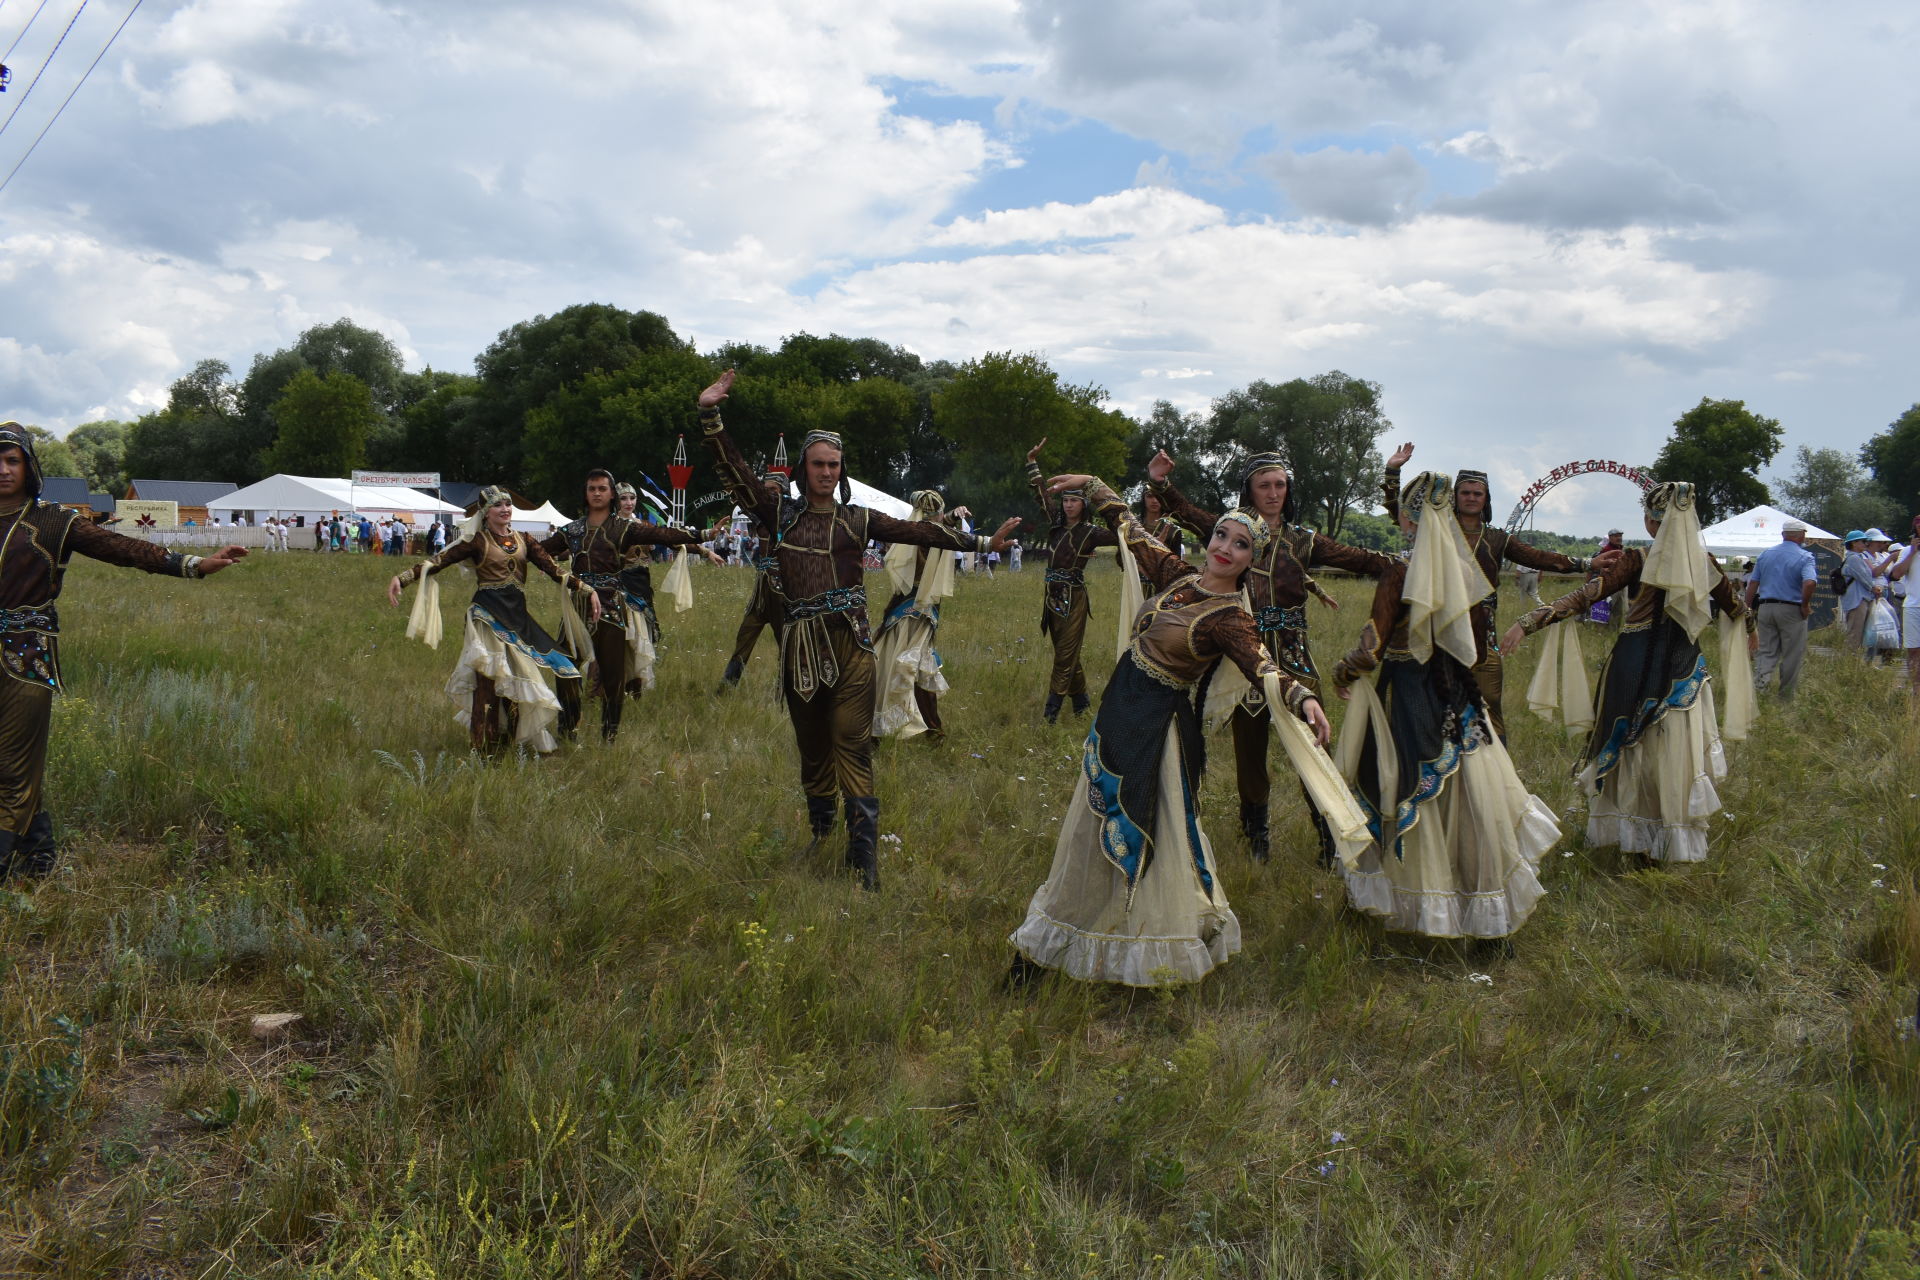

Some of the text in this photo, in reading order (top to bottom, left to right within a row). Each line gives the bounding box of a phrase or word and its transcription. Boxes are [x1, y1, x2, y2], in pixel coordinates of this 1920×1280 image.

[1521, 478, 1546, 505] ЫК
[1550, 461, 1581, 482] БУЕ
[1586, 459, 1640, 483] САБАН
